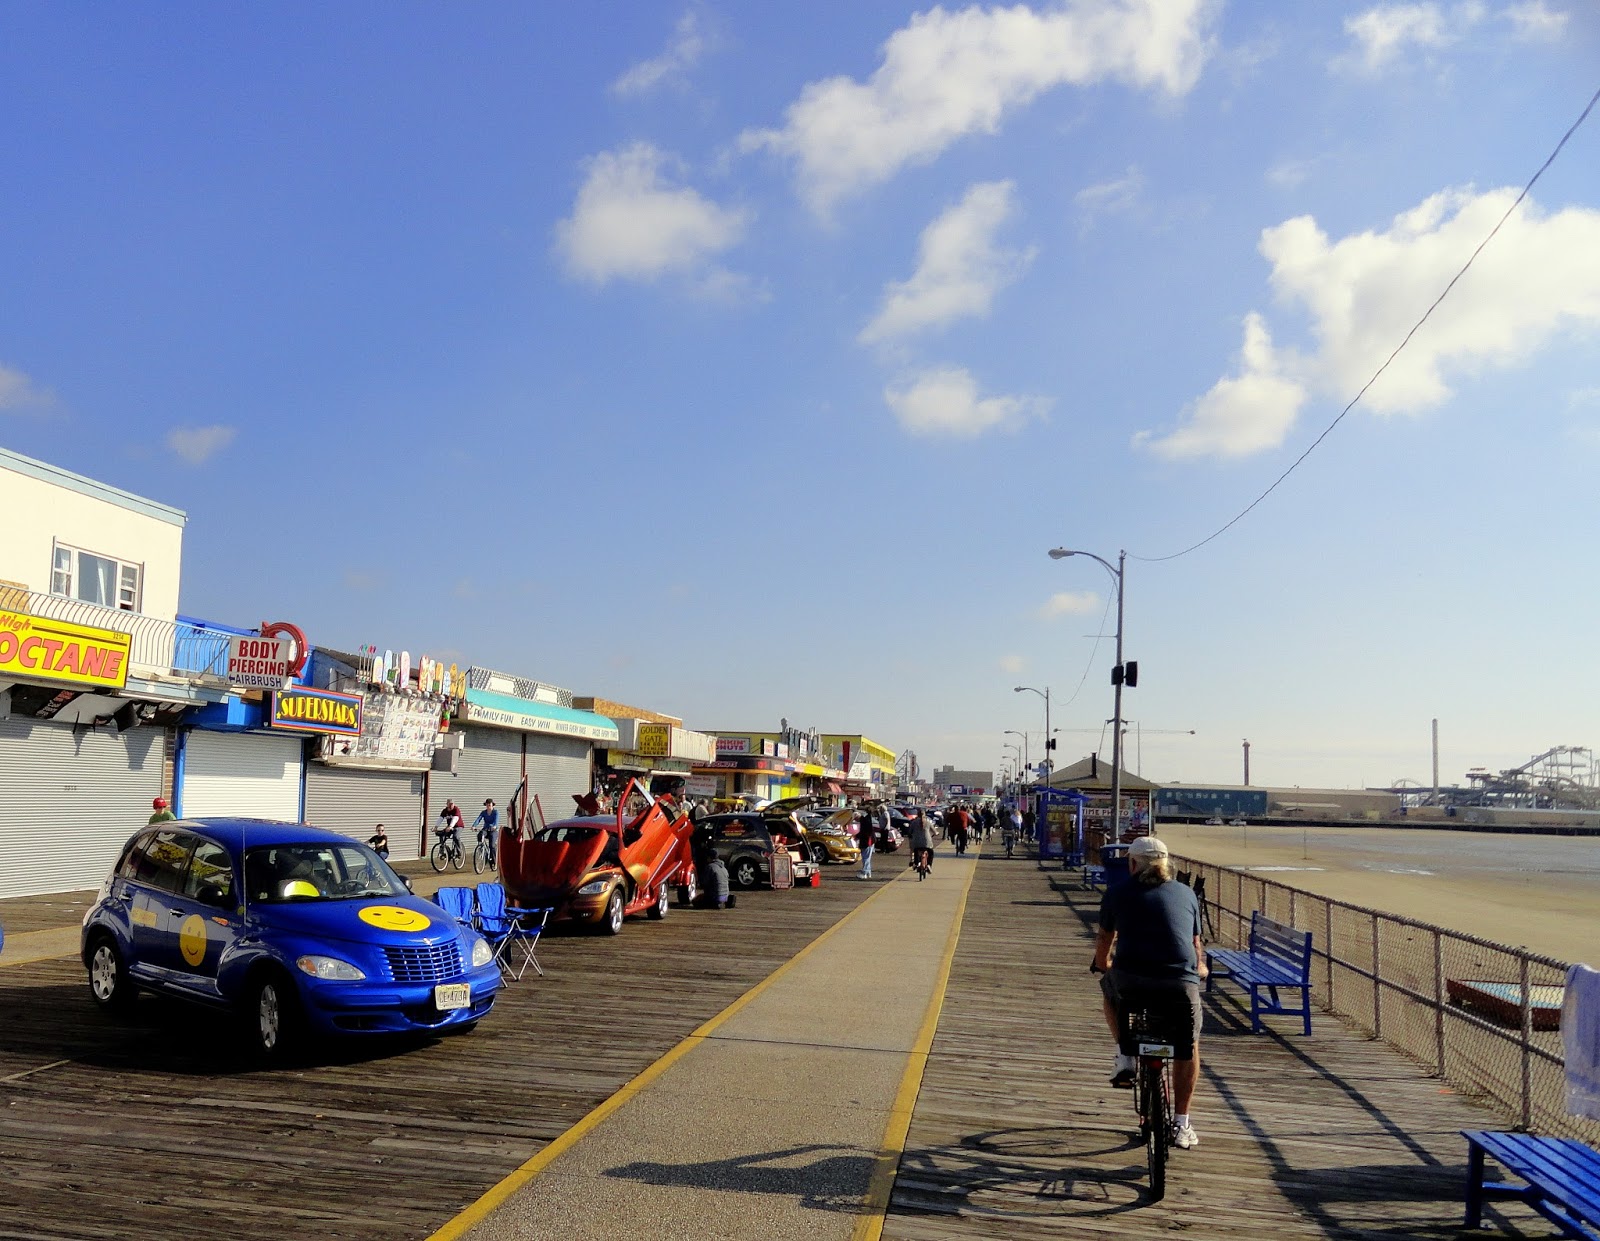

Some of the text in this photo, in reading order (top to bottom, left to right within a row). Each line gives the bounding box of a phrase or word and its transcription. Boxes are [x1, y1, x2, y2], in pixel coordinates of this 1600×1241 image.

[0, 614, 31, 631] High
[0, 631, 125, 680] OCTANE
[238, 640, 280, 659] BODY
[228, 659, 285, 676] PIERCING
[235, 674, 282, 688] AIRBRUSH
[280, 696, 355, 725] SUPERSTARS
[473, 708, 551, 730] FAMILY FUN EASY WIN
[640, 726, 668, 734] GOLDEN
